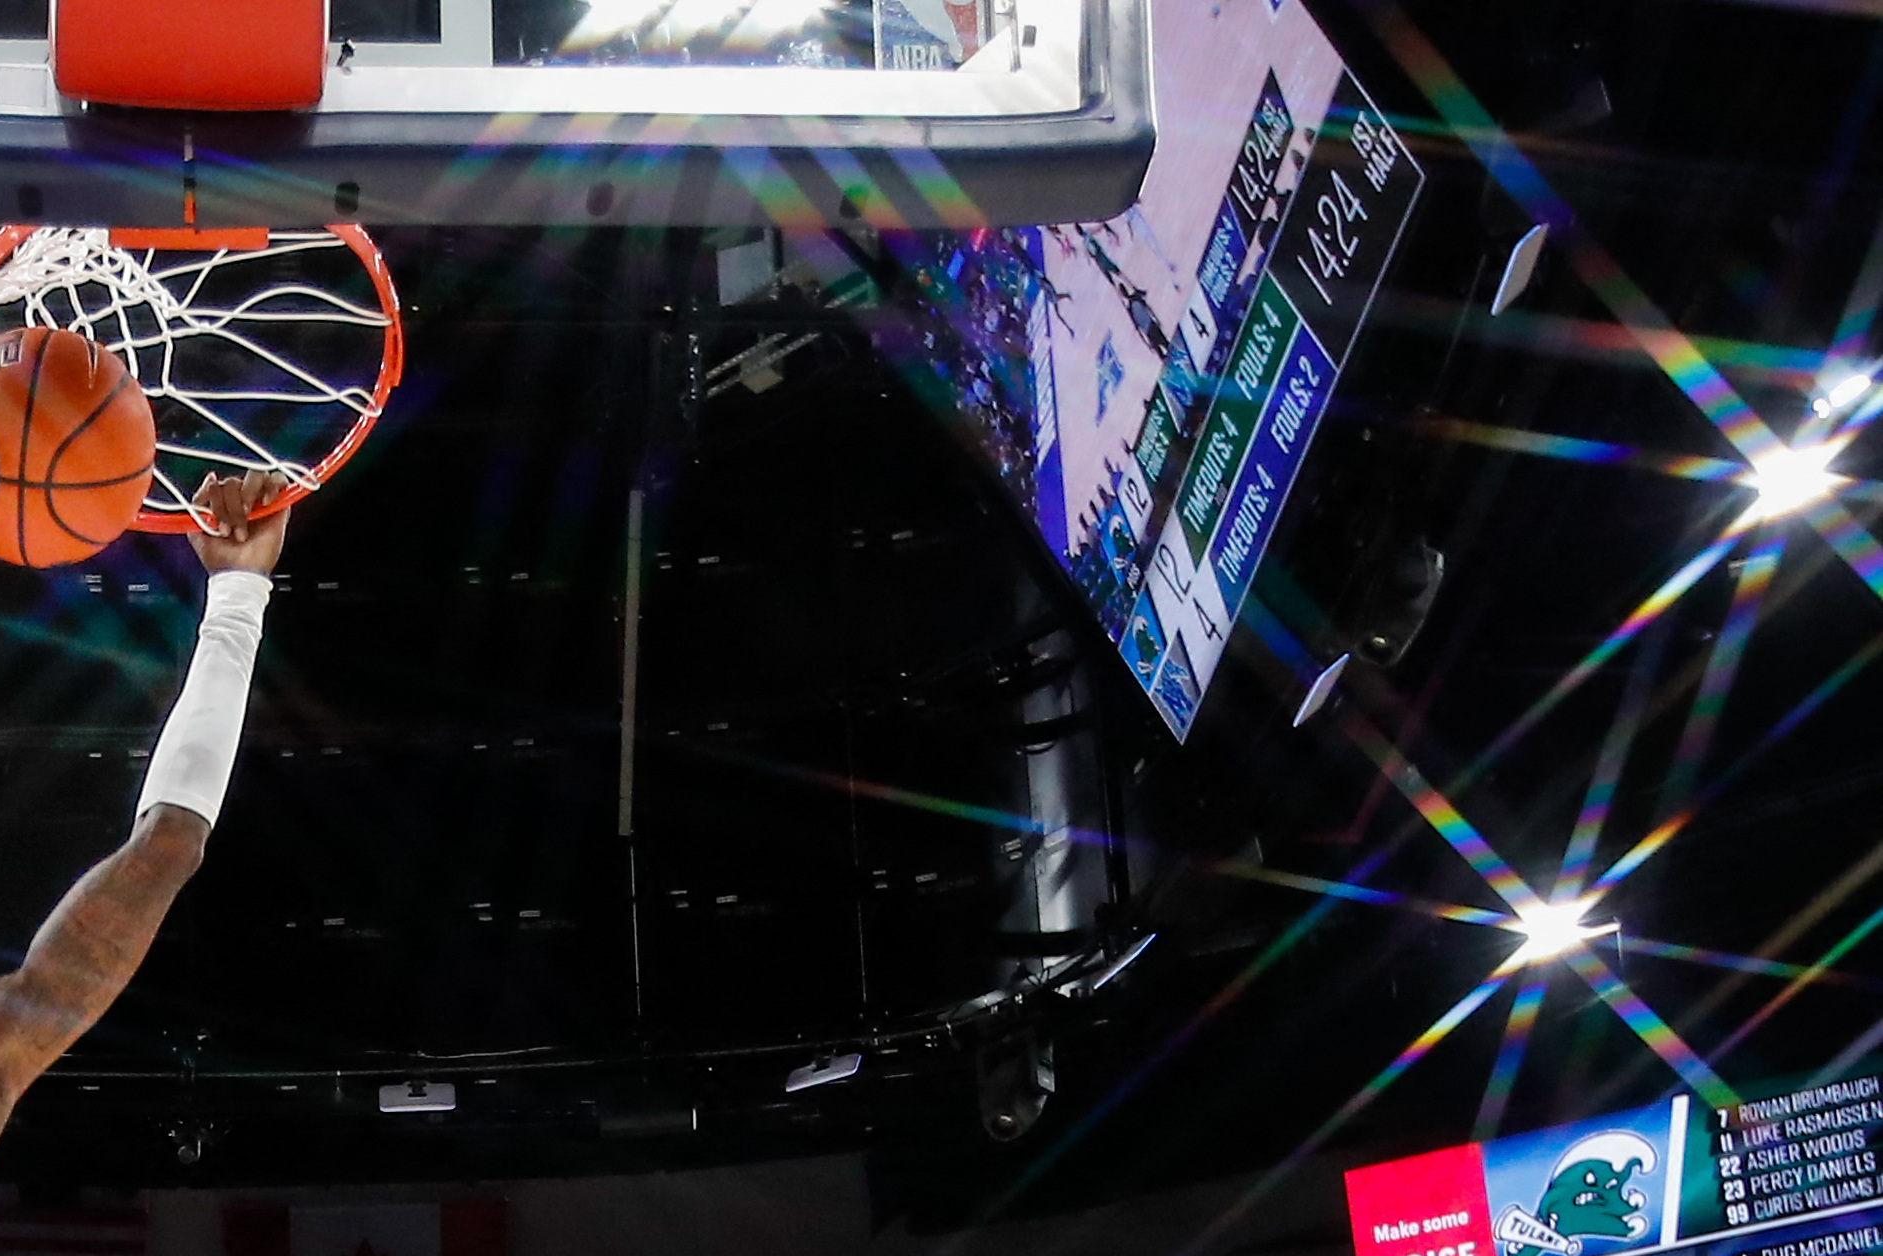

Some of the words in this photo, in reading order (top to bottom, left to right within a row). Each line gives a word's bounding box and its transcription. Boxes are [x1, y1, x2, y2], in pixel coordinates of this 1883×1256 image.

[1296, 169, 1368, 306] 14:24
[1234, 321, 1276, 400] FOULS:
[1262, 301, 1282, 329] 4
[1270, 375, 1314, 454] FOULS:
[1297, 354, 1321, 388] 2
[1182, 429, 1234, 534] TIMEOUTS:
[1220, 411, 1240, 438] 4
[1217, 481, 1270, 585] TIMEOUTS:
[1256, 462, 1276, 491] 4
[1155, 543, 1192, 604] 12
[1193, 596, 1224, 641] 4
[1717, 1109, 1729, 1129] 7
[1738, 1096, 1791, 1124] ROWAN
[1791, 1076, 1879, 1113] BRUMBAUGH
[1720, 1132, 1734, 1153] 11
[1742, 1122, 1783, 1148] LUKE
[1784, 1100, 1883, 1139] RASMUSSEN
[1719, 1155, 1742, 1178] 22
[1747, 1143, 1801, 1172] ASHER
[1802, 1129, 1867, 1160] WOODS
[1723, 1179, 1746, 1202] 23
[1750, 1166, 1803, 1196] PERCY
[1806, 1150, 1877, 1183] DANIELS
[1373, 1220, 1419, 1244] Make
[1422, 1209, 1469, 1236] some
[1726, 1202, 1750, 1226] 99
[1753, 1191, 1803, 1221] CURTIS
[1804, 1178, 1875, 1209] WILLIAMS
